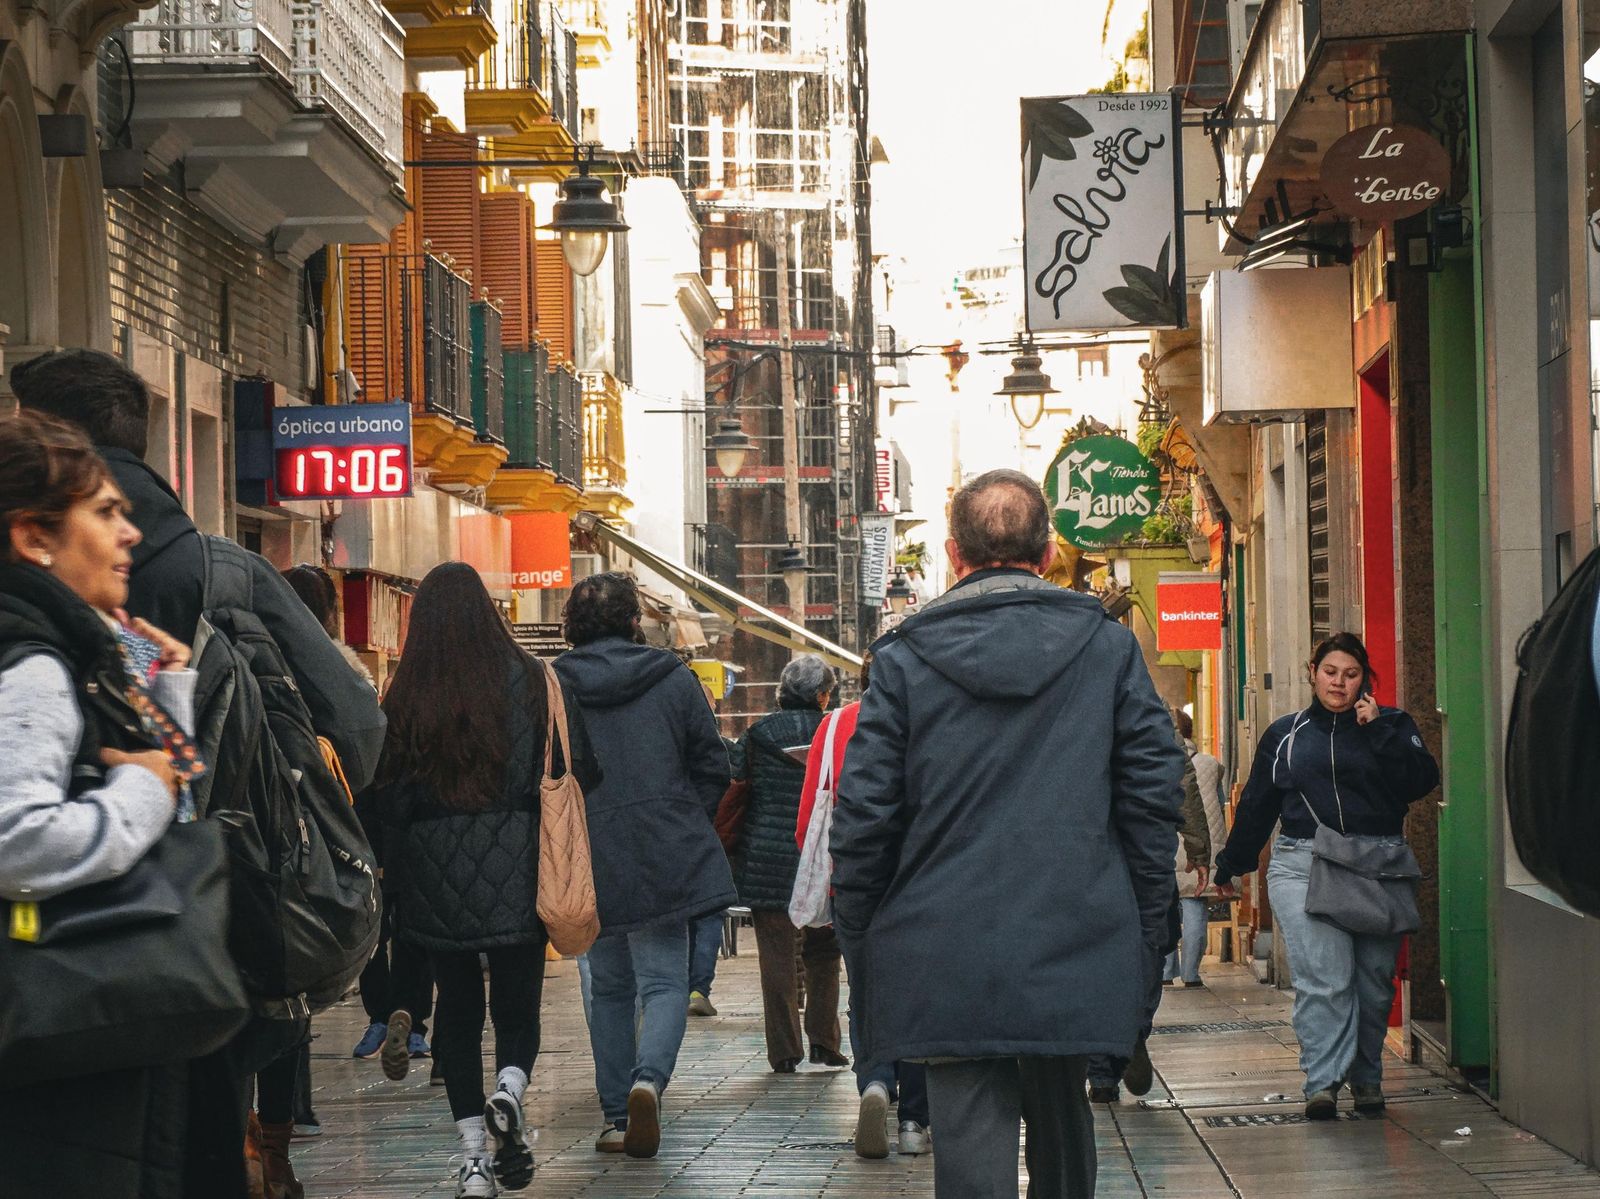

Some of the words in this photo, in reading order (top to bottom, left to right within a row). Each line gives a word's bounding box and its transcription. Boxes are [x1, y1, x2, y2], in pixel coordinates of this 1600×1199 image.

[1098, 100, 1136, 112] Desde
[1139, 99, 1169, 111] 1992
[1358, 127, 1405, 159] La
[278, 416, 336, 439] óptica
[339, 415, 404, 434] urbano
[296, 448, 403, 493] 17:06
[1111, 464, 1150, 478] Tiendas
[868, 526, 888, 593] ANDAMIOS
[512, 569, 563, 587] range
